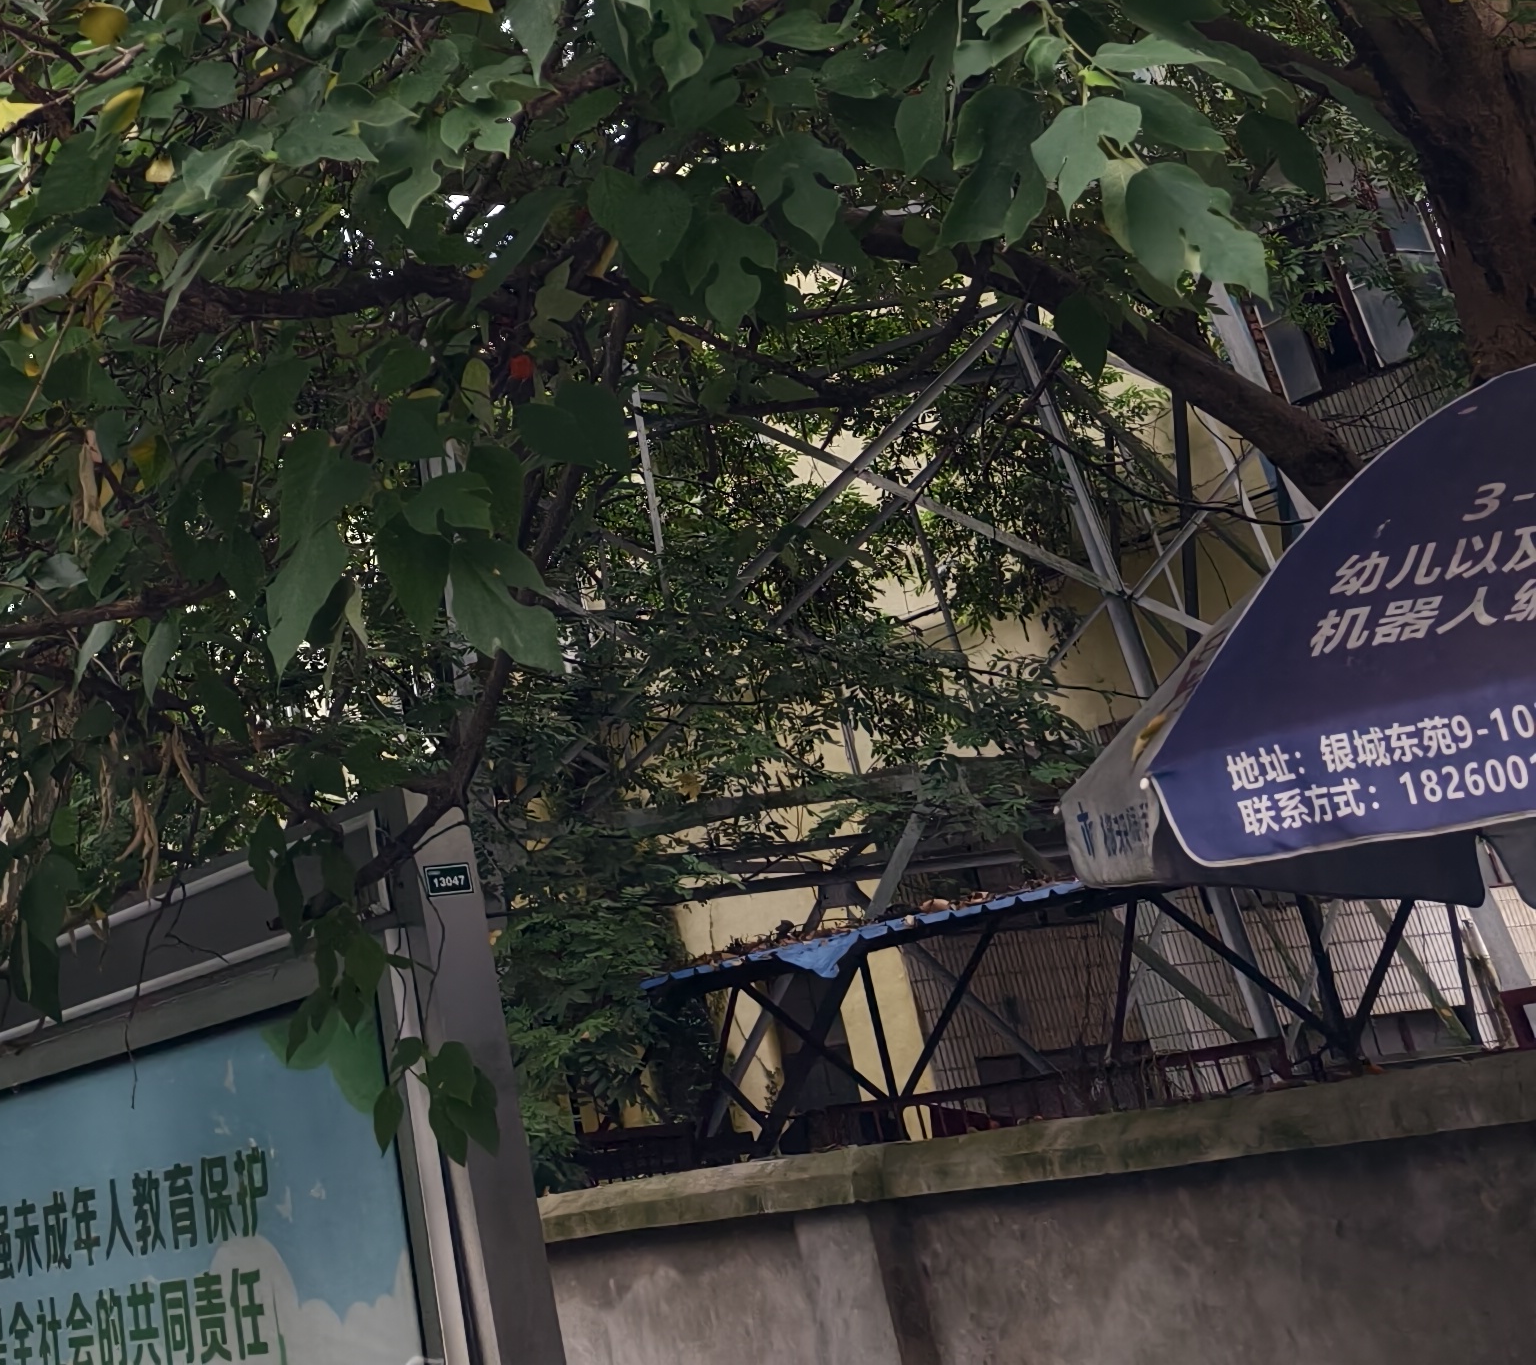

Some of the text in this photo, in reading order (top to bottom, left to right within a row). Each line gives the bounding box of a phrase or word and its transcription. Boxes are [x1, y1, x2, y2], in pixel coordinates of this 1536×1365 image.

[1226, 702, 1536, 791] 地址：银城东苑9-10
[1237, 753, 1536, 836] 联系方式：182600
[433, 874, 465, 888] 13047
